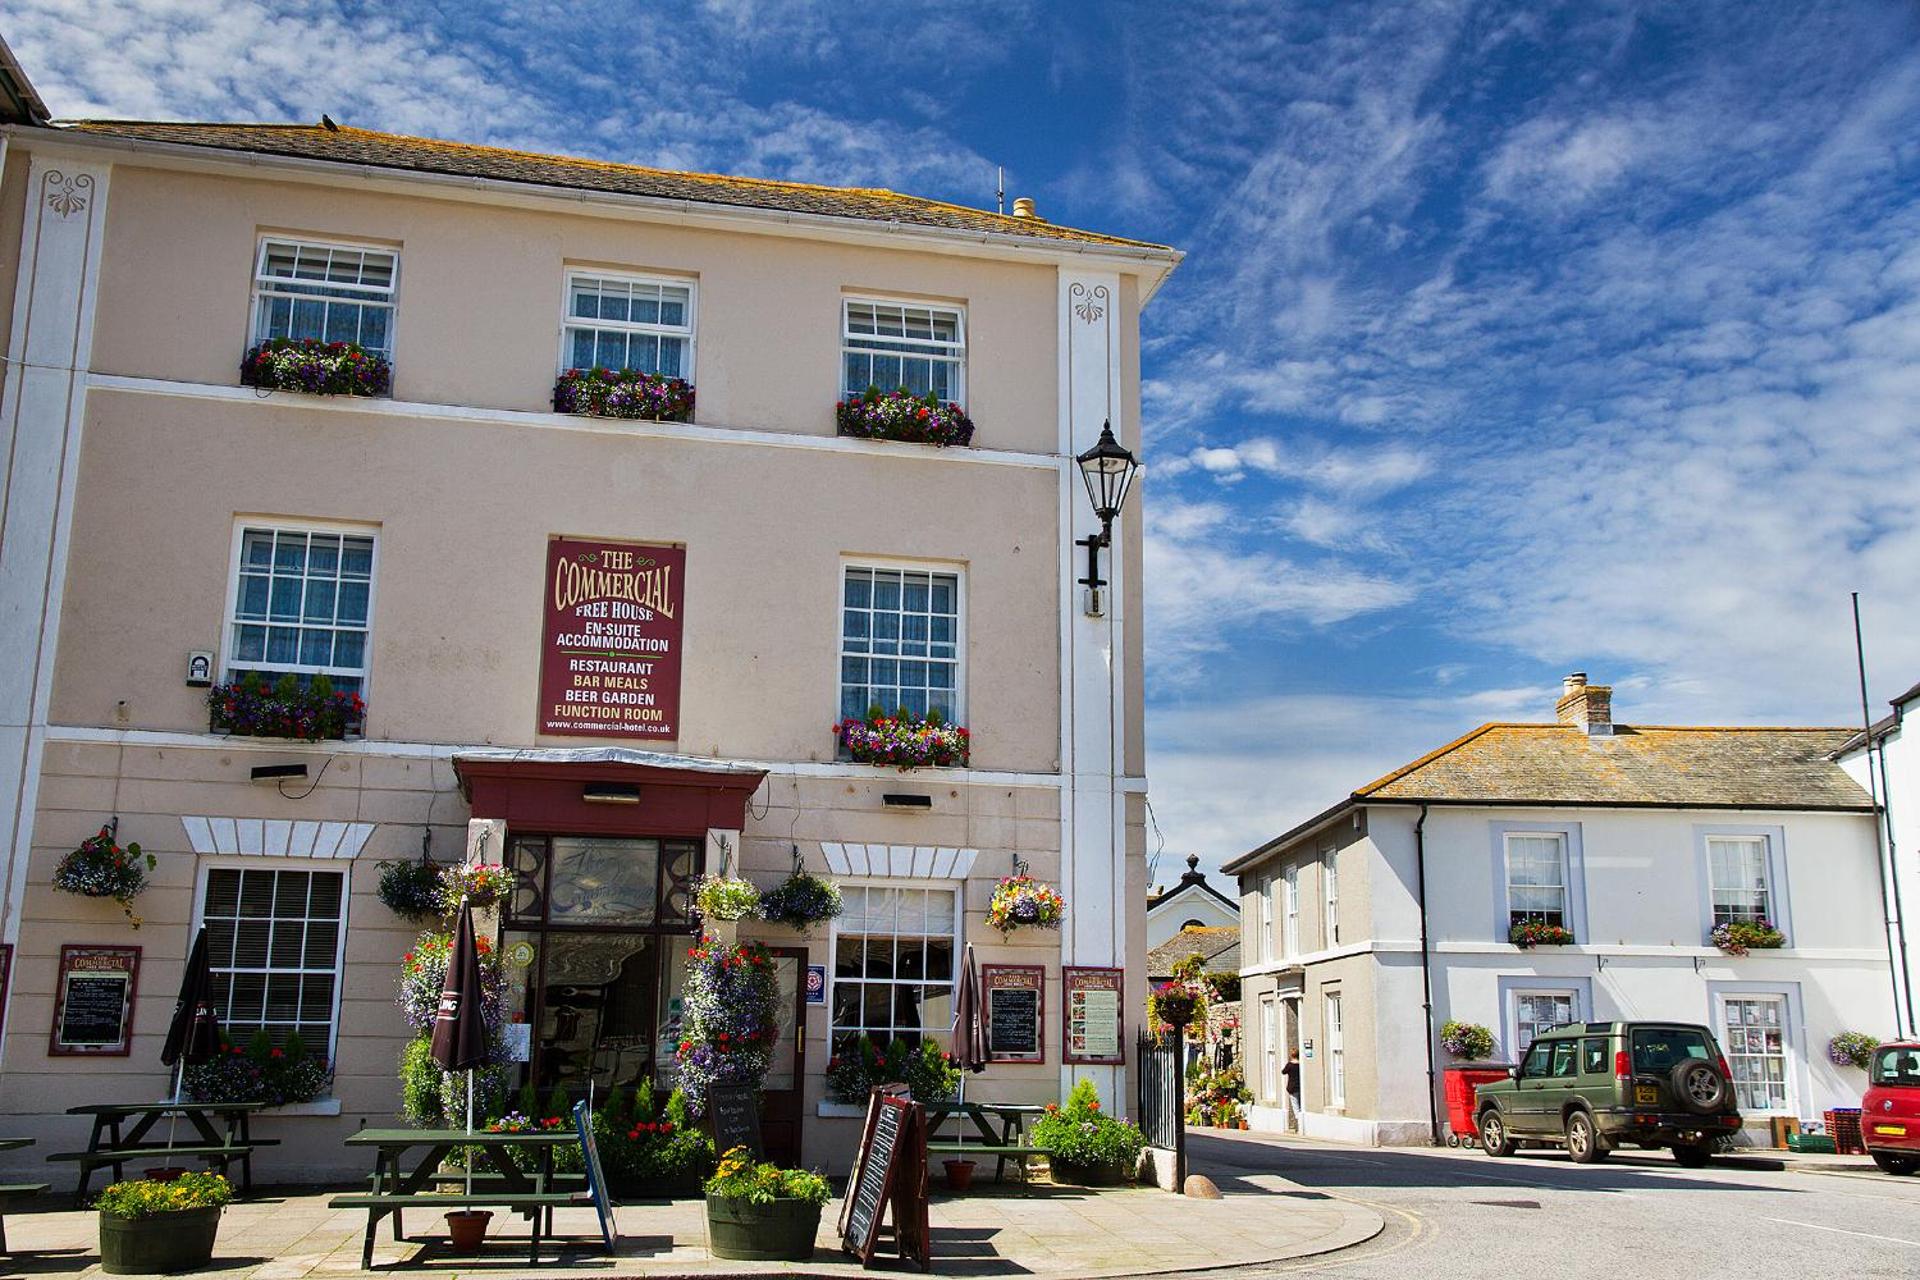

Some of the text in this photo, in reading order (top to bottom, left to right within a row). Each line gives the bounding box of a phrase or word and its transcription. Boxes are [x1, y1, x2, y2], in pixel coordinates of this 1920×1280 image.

[601, 550, 633, 570] THE
[555, 557, 674, 619] COMMERCIAL
[575, 602, 654, 621] FREE HOUSE
[586, 622, 641, 637] EN-SUITE
[556, 633, 669, 652] ACCOMMODATION
[570, 660, 654, 675] RESTAURANT
[574, 675, 648, 690] BAR MEALS
[565, 690, 655, 706] BEER GARDEN
[554, 704, 663, 721] FUNCTION ROOM
[546, 720, 671, 733] www.commercial-hotel.co.uk
